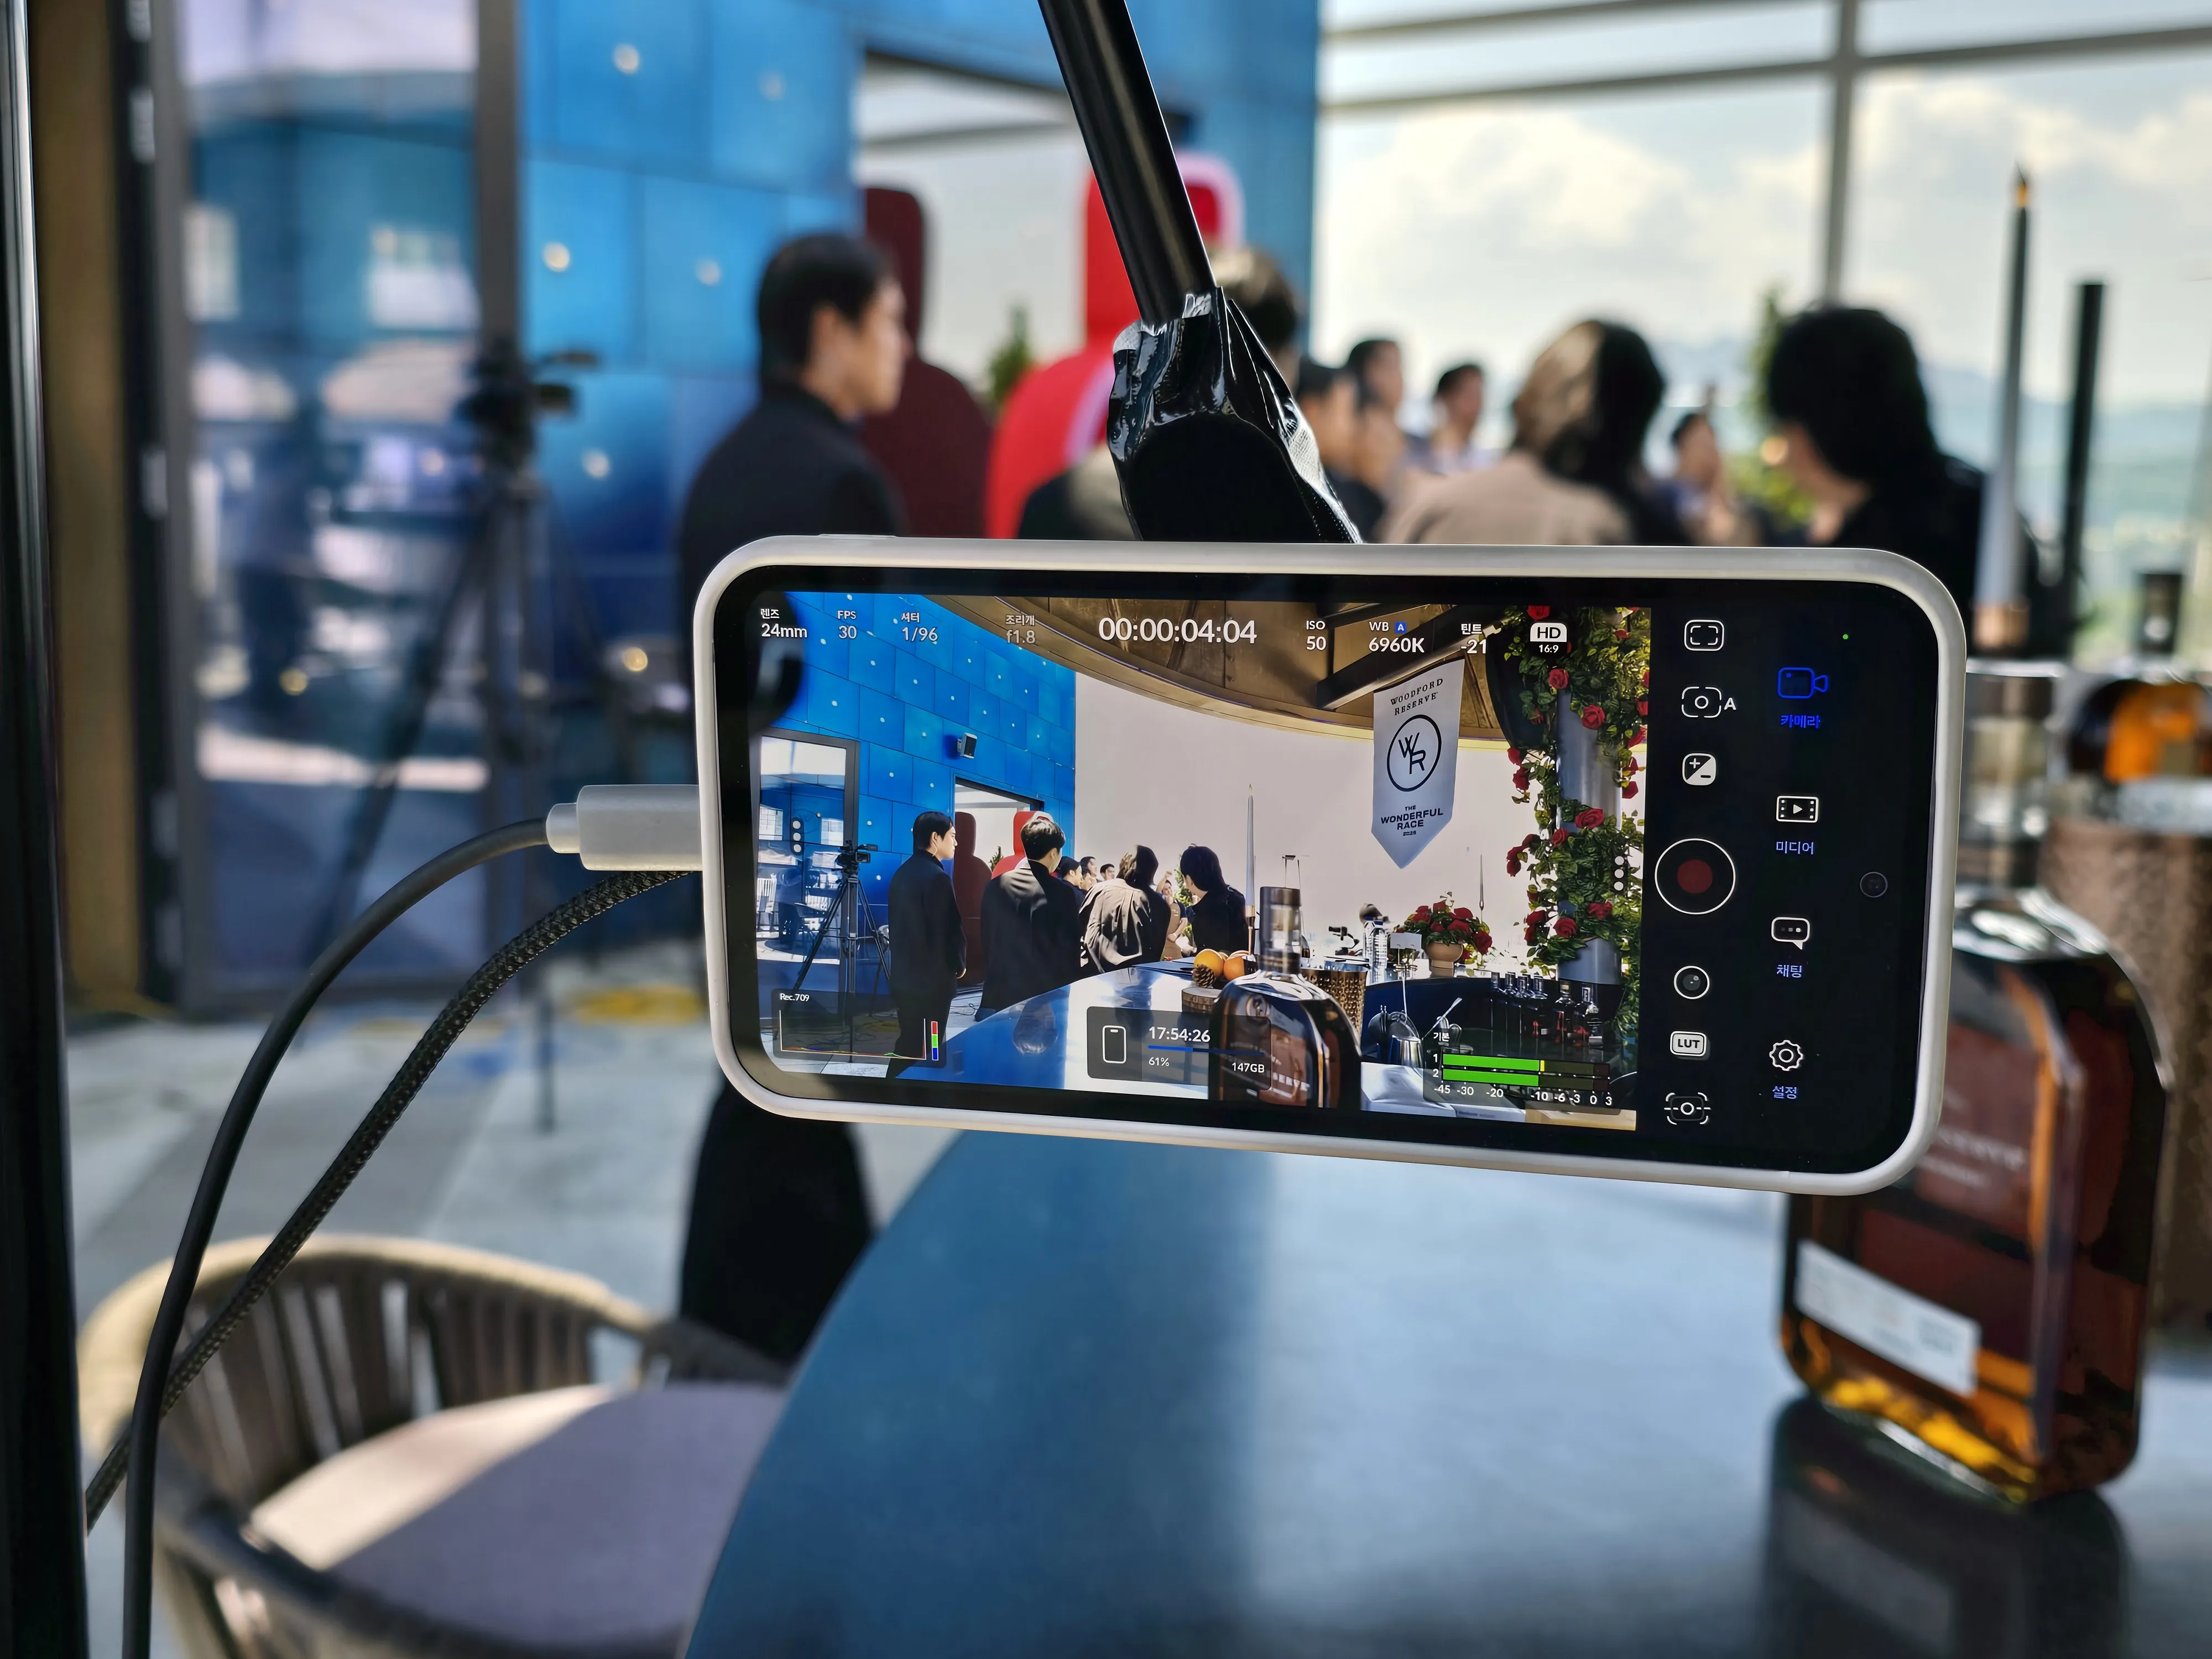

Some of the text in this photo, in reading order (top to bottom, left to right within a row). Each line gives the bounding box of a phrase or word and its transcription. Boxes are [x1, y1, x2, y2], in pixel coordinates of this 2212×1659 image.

[760, 608, 780, 619] 렌즈
[837, 610, 857, 620] FPS
[901, 612, 920, 623] 셔터
[1005, 614, 1036, 626] 조리개
[761, 623, 807, 638] 24mm
[1098, 617, 1258, 644] 00:00:04:04
[1306, 620, 1326, 630] ISO
[1369, 621, 1389, 632] WB
[1461, 623, 1483, 635] 틴트
[838, 625, 857, 639] 30
[901, 626, 938, 643] 1/96
[1006, 629, 1036, 644] f1.8
[1537, 626, 1561, 639] HD
[1306, 636, 1327, 650] 50
[1368, 638, 1425, 654] 6960K
[1460, 639, 1486, 654] -21
[1538, 644, 1559, 653] 16:9
[1390, 678, 1443, 706] WOODFORD
[1395, 692, 1438, 716] RESERVE
[1724, 697, 1736, 711] A
[1780, 714, 1820, 729] 카메라
[1380, 807, 1444, 824] WONDERFUL
[1397, 819, 1424, 830] RACE
[1776, 841, 1814, 855] 미디어
[1776, 964, 1803, 978] 채팅
[779, 993, 810, 1002] Rec.709
[1149, 1026, 1211, 1043] 17:54:26
[1677, 1038, 1700, 1049] LUT
[1148, 1057, 1170, 1067] 61%
[1433, 1053, 1438, 1063] 1
[1232, 1062, 1265, 1073] 147GB
[1433, 1068, 1439, 1078] 2
[1434, 1084, 1613, 1106] -45 -30 -20 -10 -6 -3 0 3
[1772, 1086, 1798, 1099] 설정
